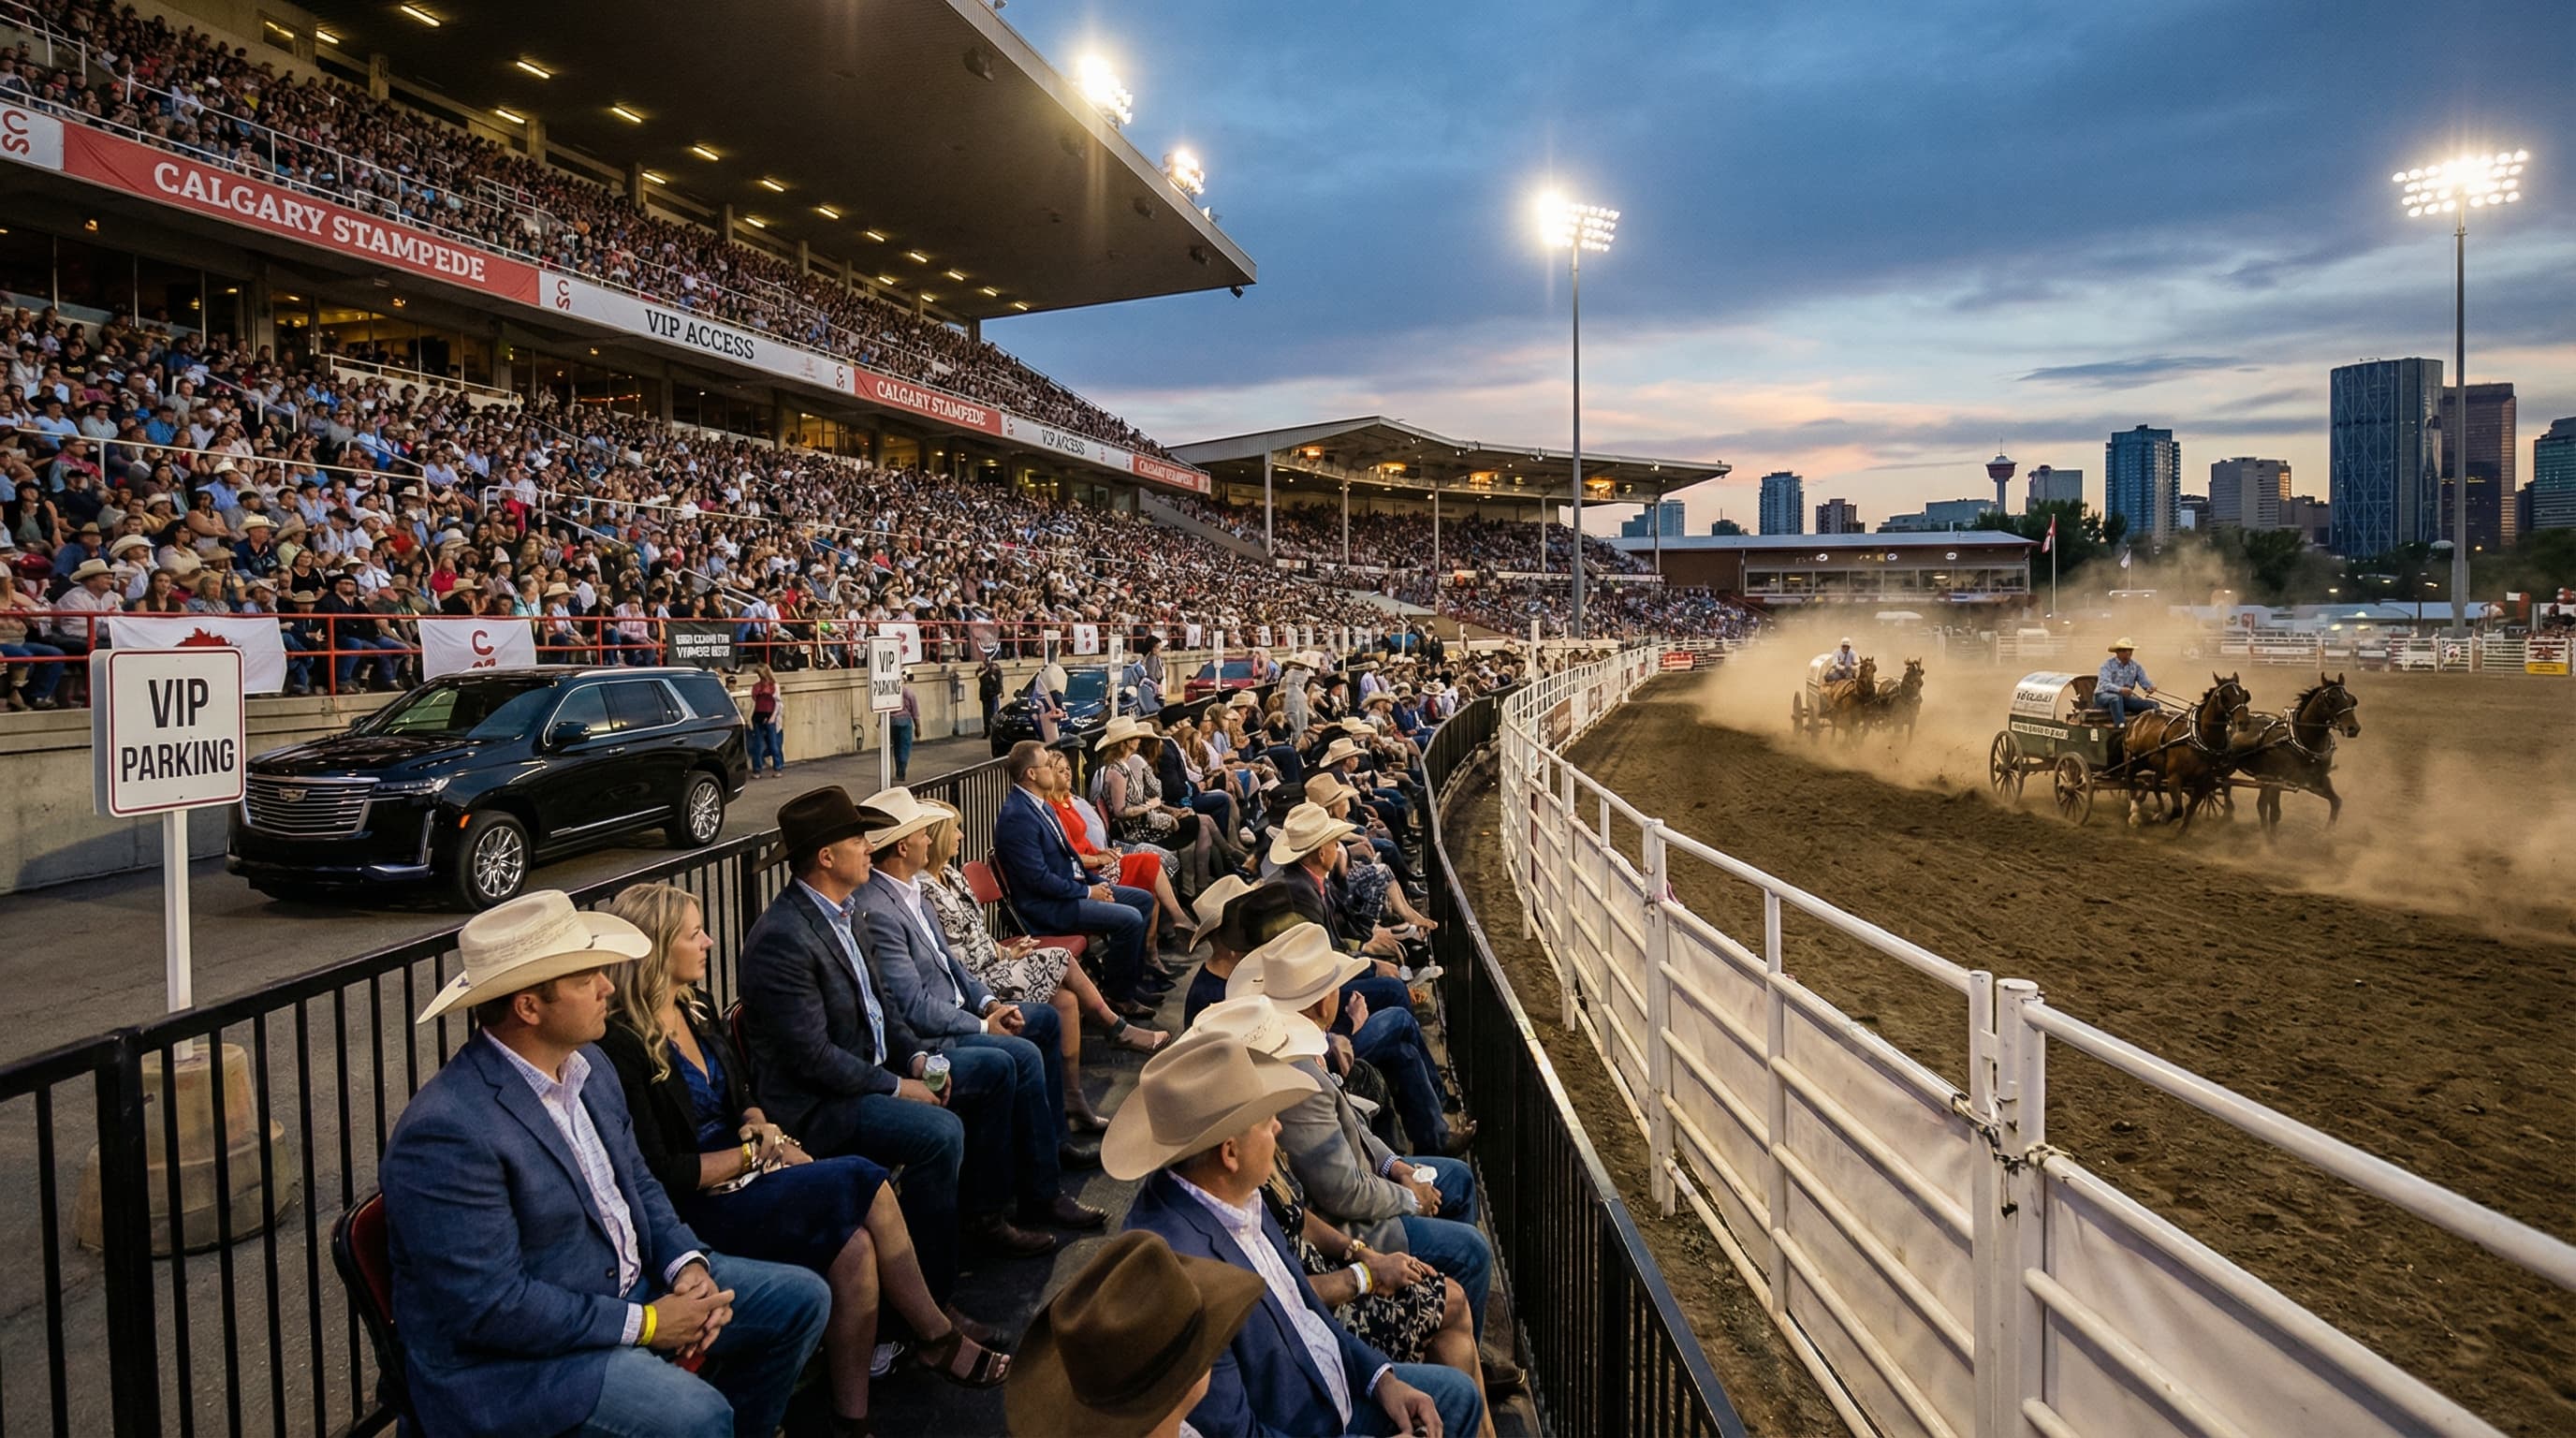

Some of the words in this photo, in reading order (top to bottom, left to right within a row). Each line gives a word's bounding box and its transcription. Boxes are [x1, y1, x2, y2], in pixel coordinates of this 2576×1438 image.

[154, 162, 327, 235] CALGARY
[332, 214, 486, 283] STAMPEDE
[645, 308, 681, 338] VIP
[684, 321, 754, 360] ACCESS
[876, 380, 930, 411] CALGARY
[878, 651, 895, 673] VIP
[148, 678, 209, 728] VIP
[122, 738, 234, 783] PARKING
